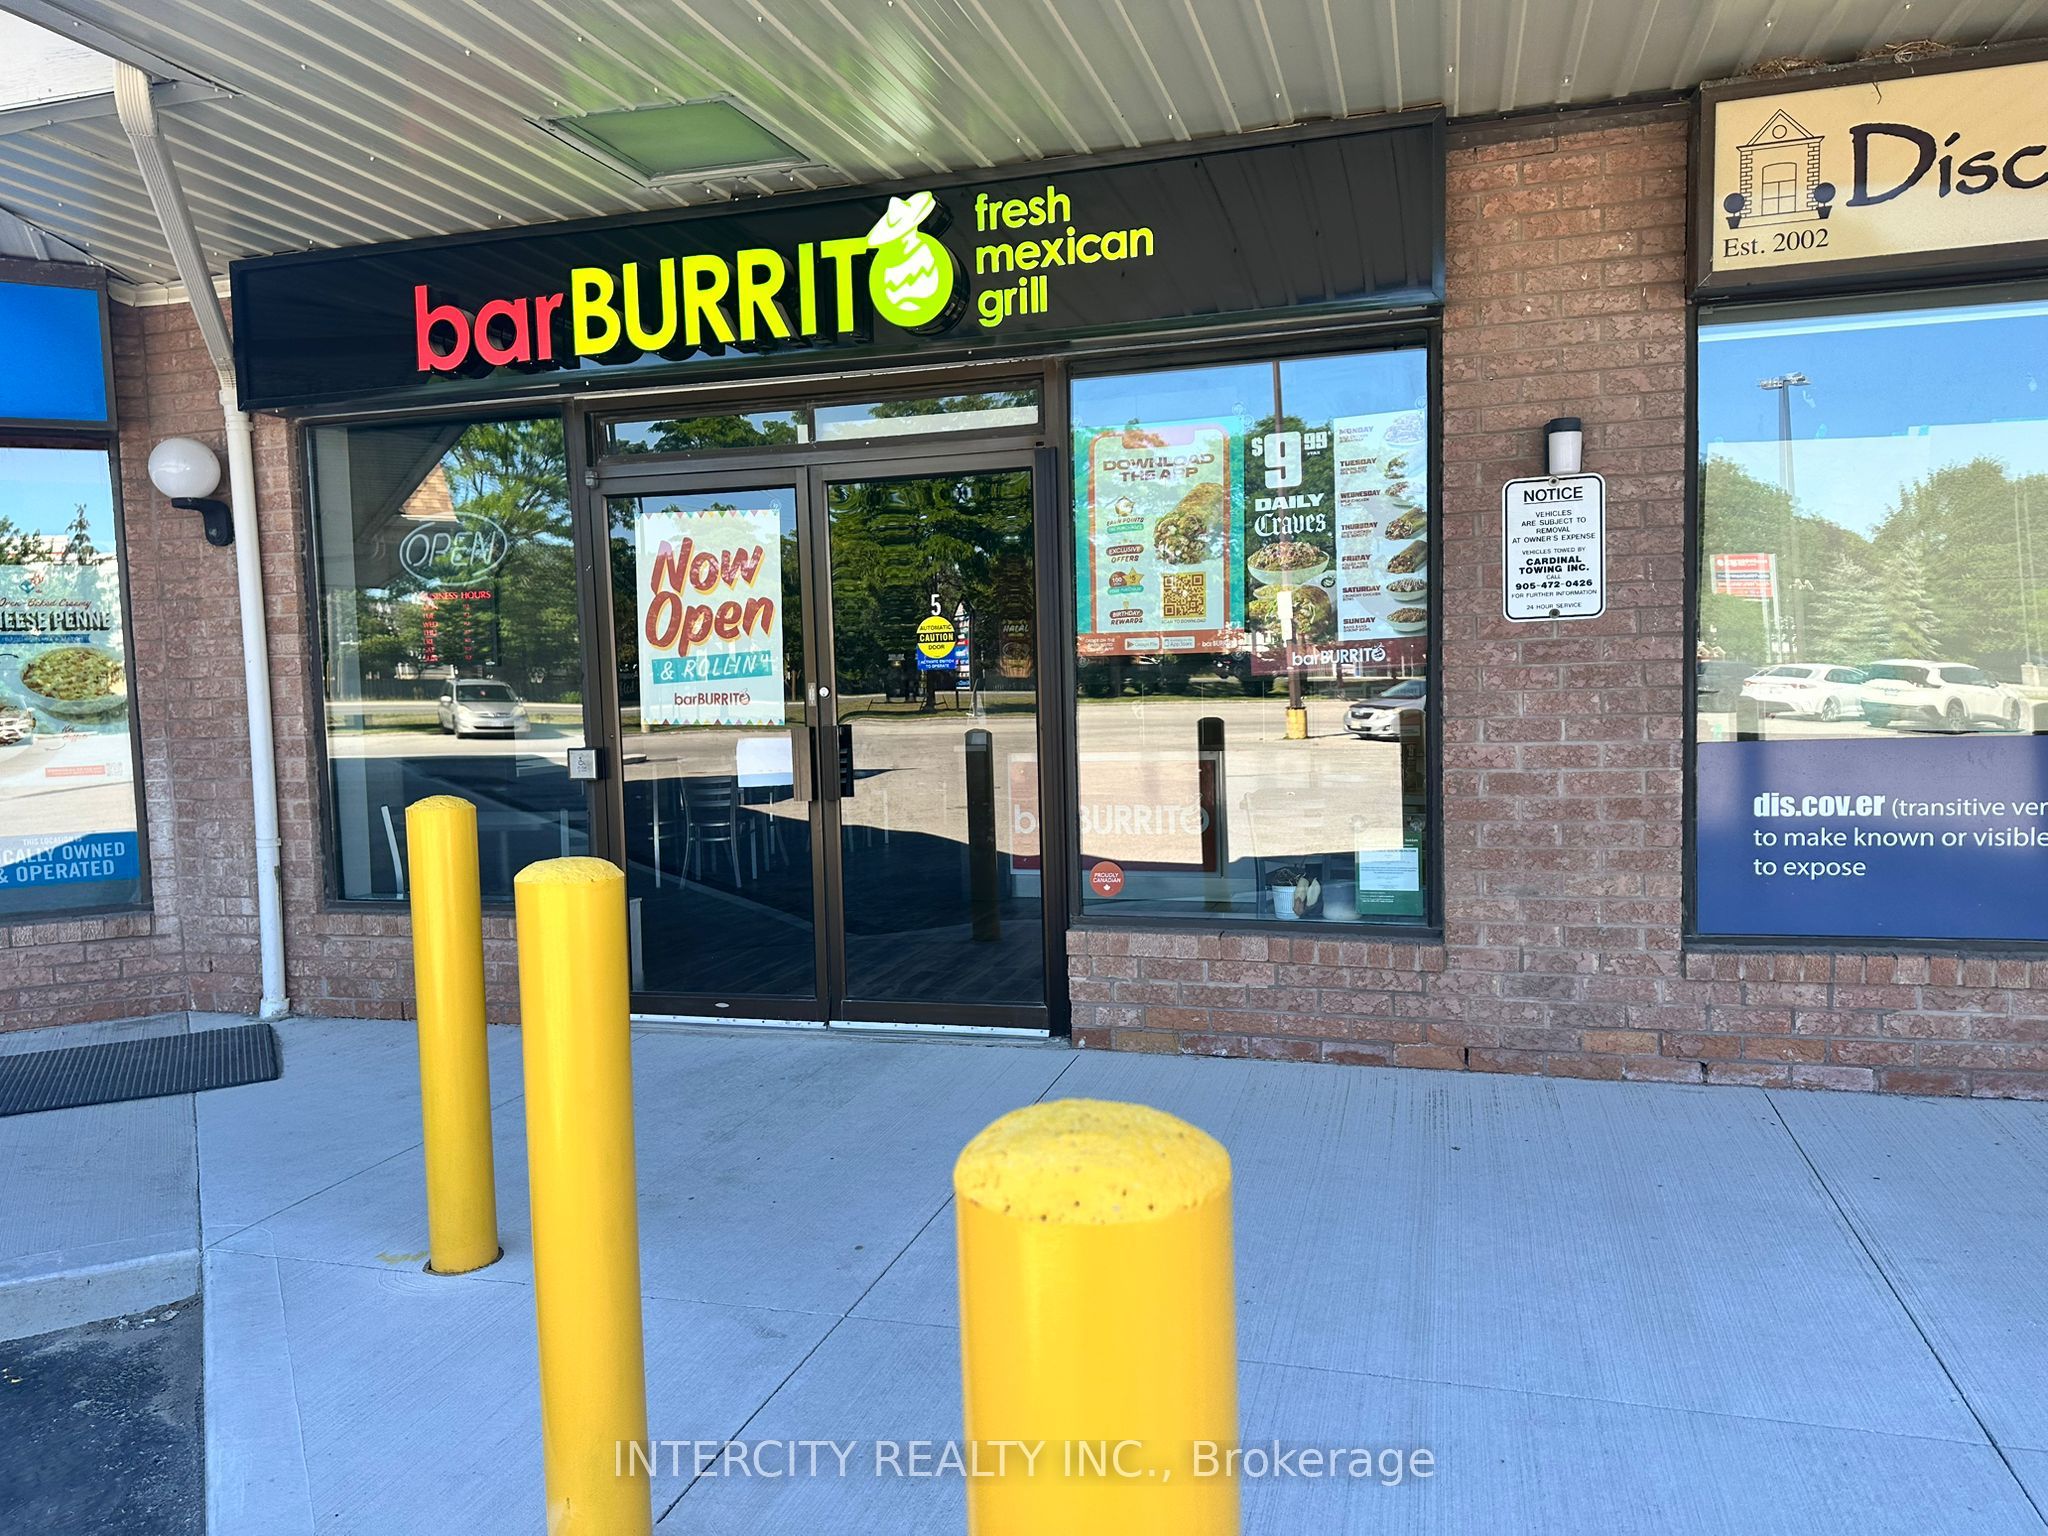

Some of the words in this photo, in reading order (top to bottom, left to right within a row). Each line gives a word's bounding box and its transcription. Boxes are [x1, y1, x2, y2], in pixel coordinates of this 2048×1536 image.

[1846, 123, 2048, 207] Disc
[975, 184, 1072, 232] fresh
[976, 227, 1155, 275] mexican
[1723, 237, 1766, 258] Est.
[1772, 228, 1830, 253] 2002
[413, 229, 954, 373] barBURRITO
[978, 274, 1048, 327] grill
[1339, 426, 1374, 434] MONDAY
[1103, 453, 1215, 471] DOWNLOAD
[1340, 458, 1377, 466] TUESDAY
[1120, 470, 1155, 482] THE
[1255, 493, 1325, 511] DAILY
[1340, 490, 1380, 498] WEDNESDAY
[1523, 486, 1583, 503] NOTICE
[1535, 510, 1572, 518] VEHICLES
[1539, 518, 1573, 526] SUBJECT
[1254, 513, 1327, 537] Craves
[1341, 522, 1378, 530] THURSDAY
[1536, 526, 1570, 534] REMOVAL
[1524, 535, 1559, 543] OWNER'S
[1561, 533, 1596, 541] EXPENSE
[406, 531, 496, 567] OPEN
[650, 537, 764, 596] Now
[1111, 555, 1139, 563] OFFERS
[1342, 554, 1371, 562] FRIDAY
[1526, 556, 1582, 566] CARDINAL
[1519, 565, 1562, 575] TOWING
[1567, 563, 1590, 572] INC.
[1342, 585, 1381, 593] SATURDAY
[1515, 579, 1593, 590] 905-472-0426
[1555, 589, 1597, 597] INFORMATION
[461, 591, 492, 599] HOURS
[931, 594, 941, 616] 5
[0, 611, 46, 631] EESE
[51, 611, 111, 631] PENNE
[645, 591, 775, 658] Open
[1111, 617, 1143, 625] REWARDS
[1343, 617, 1376, 625] SUNDAY
[919, 633, 954, 642] CAUTION
[1292, 645, 1386, 666] barBURRITO
[660, 662, 674, 681] &
[674, 690, 751, 706] barBURRITO
[1753, 793, 1886, 817] dis.cov.er
[1892, 798, 2005, 820] (transitive
[2012, 803, 2048, 816] ver
[1753, 829, 1778, 847] to
[1784, 828, 1847, 847] make
[1854, 827, 1935, 847] known
[1941, 832, 1968, 847] or
[1973, 827, 2048, 847] visible
[62, 841, 125, 860] OWNED
[0, 867, 9, 884] &
[16, 860, 115, 882] OPERATED
[1753, 859, 1778, 876] to
[1783, 861, 1867, 880] expose
